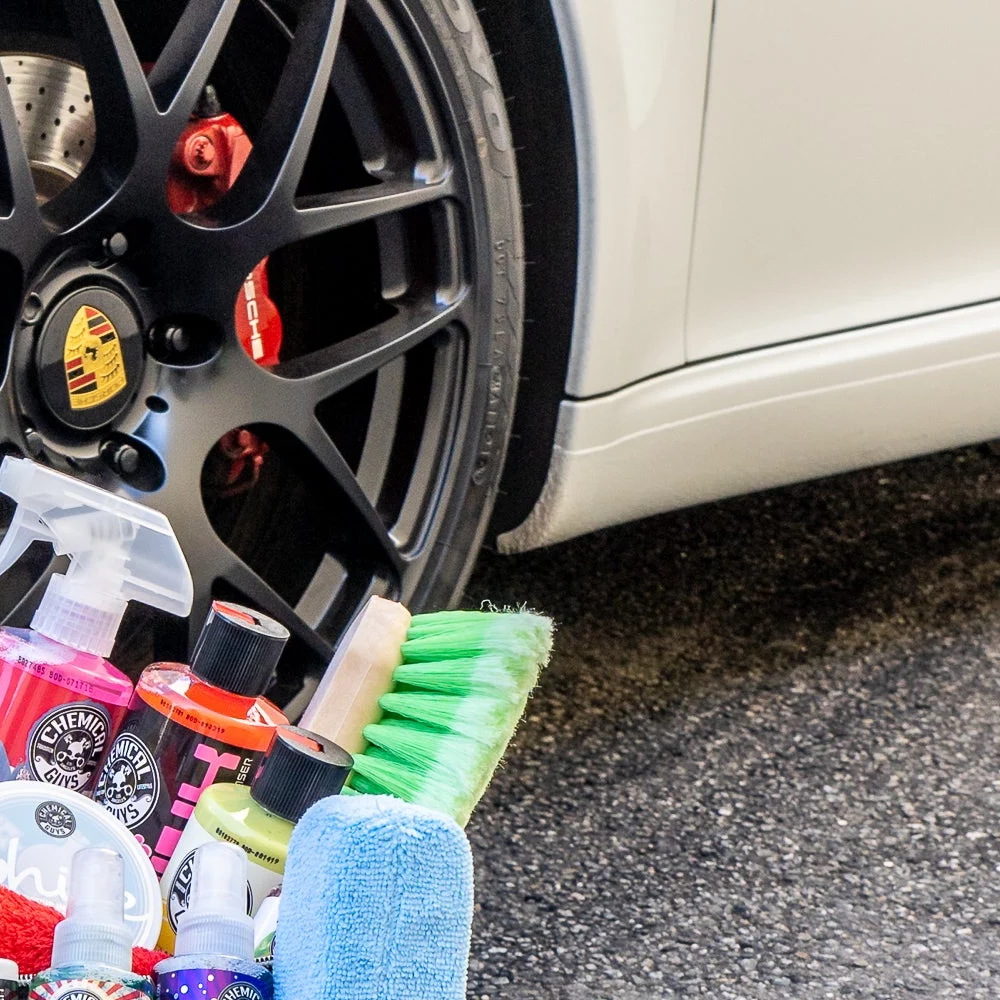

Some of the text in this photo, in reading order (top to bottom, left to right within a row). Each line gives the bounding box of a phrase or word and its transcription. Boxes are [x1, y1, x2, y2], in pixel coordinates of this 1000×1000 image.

[244, 272, 264, 360] SCHE
[41, 712, 106, 757] CHEMICAL
[44, 767, 80, 789] GUYS
[39, 804, 73, 829] CHEMICAL
[44, 823, 67, 836] GUYS
